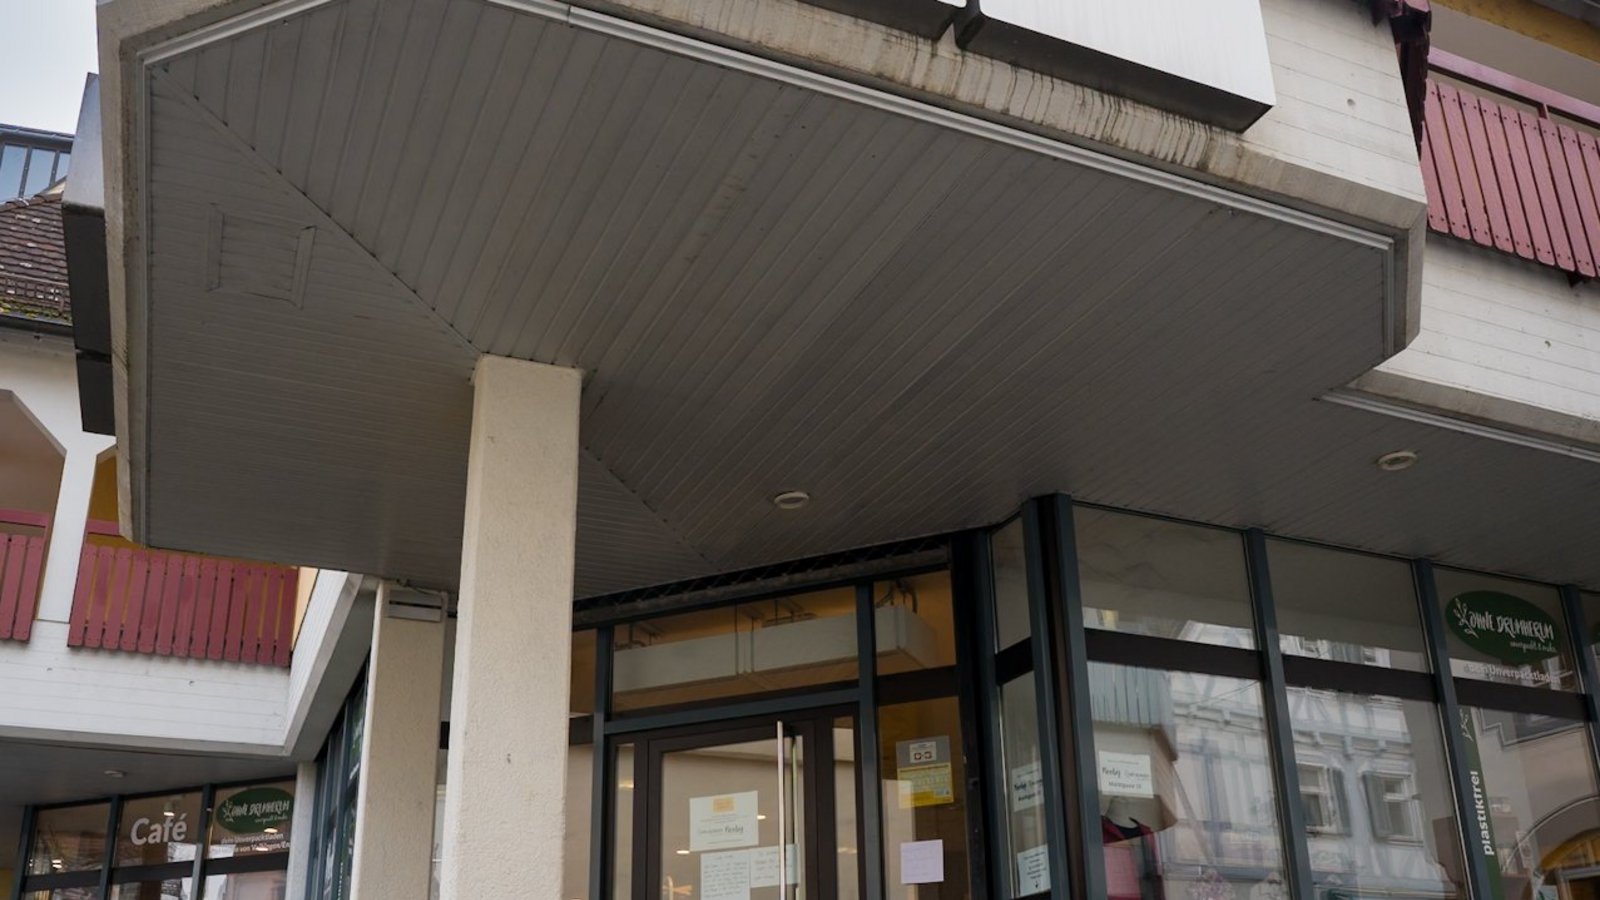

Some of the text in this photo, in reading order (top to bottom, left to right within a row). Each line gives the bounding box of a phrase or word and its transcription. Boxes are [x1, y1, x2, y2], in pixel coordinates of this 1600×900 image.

[1468, 611, 1555, 643] OHNE DRUMHERUM
[130, 813, 188, 845] Café
[1470, 771, 1495, 856] plastikfrei
